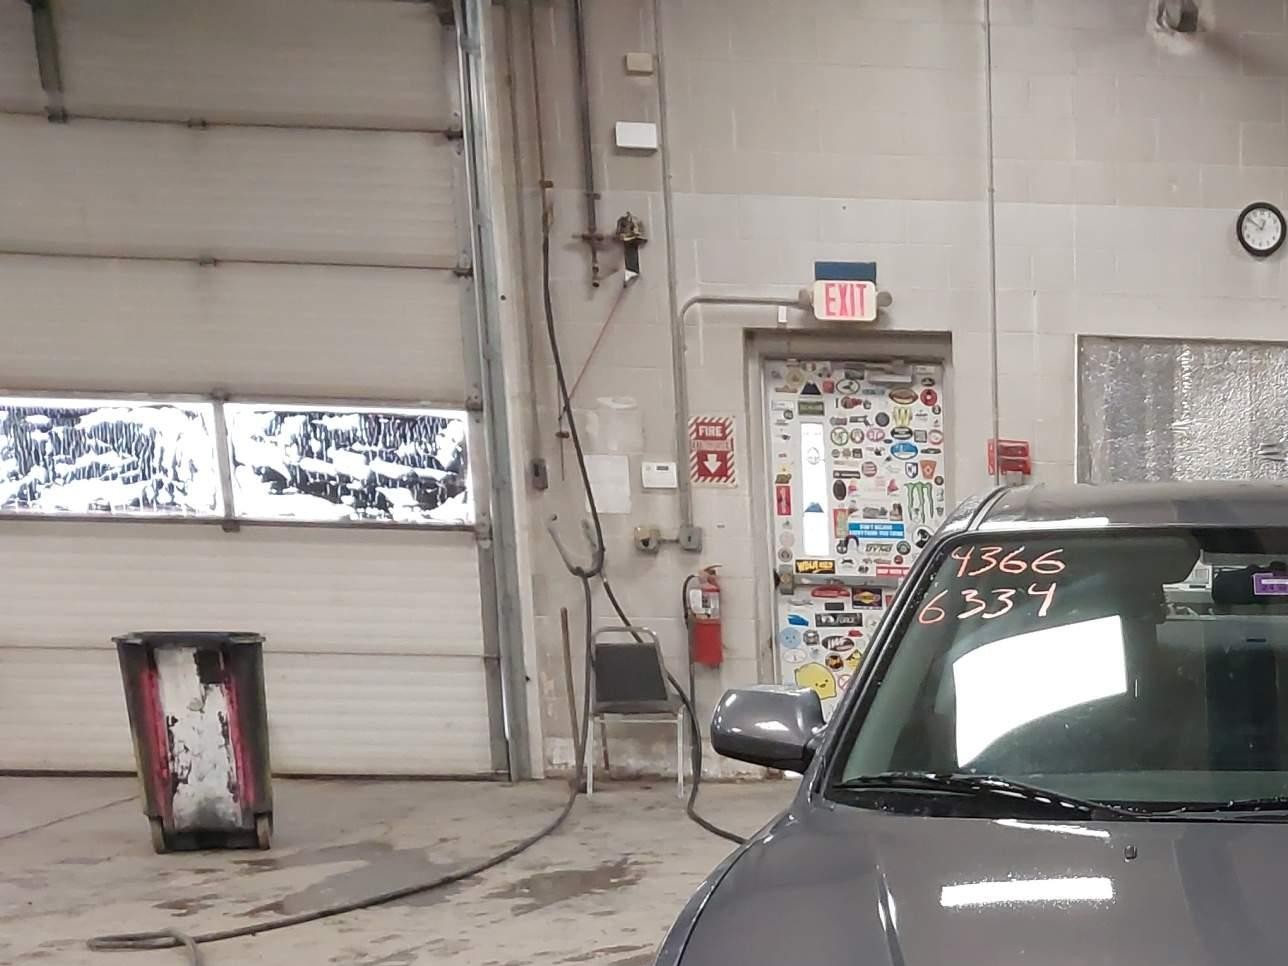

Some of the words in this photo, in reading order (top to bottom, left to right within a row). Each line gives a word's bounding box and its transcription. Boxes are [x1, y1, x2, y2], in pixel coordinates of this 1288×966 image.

[824, 283, 867, 317] EXIT
[698, 425, 723, 438] FIRE
[951, 545, 1066, 578] 4366
[918, 582, 1057, 624] 6334
